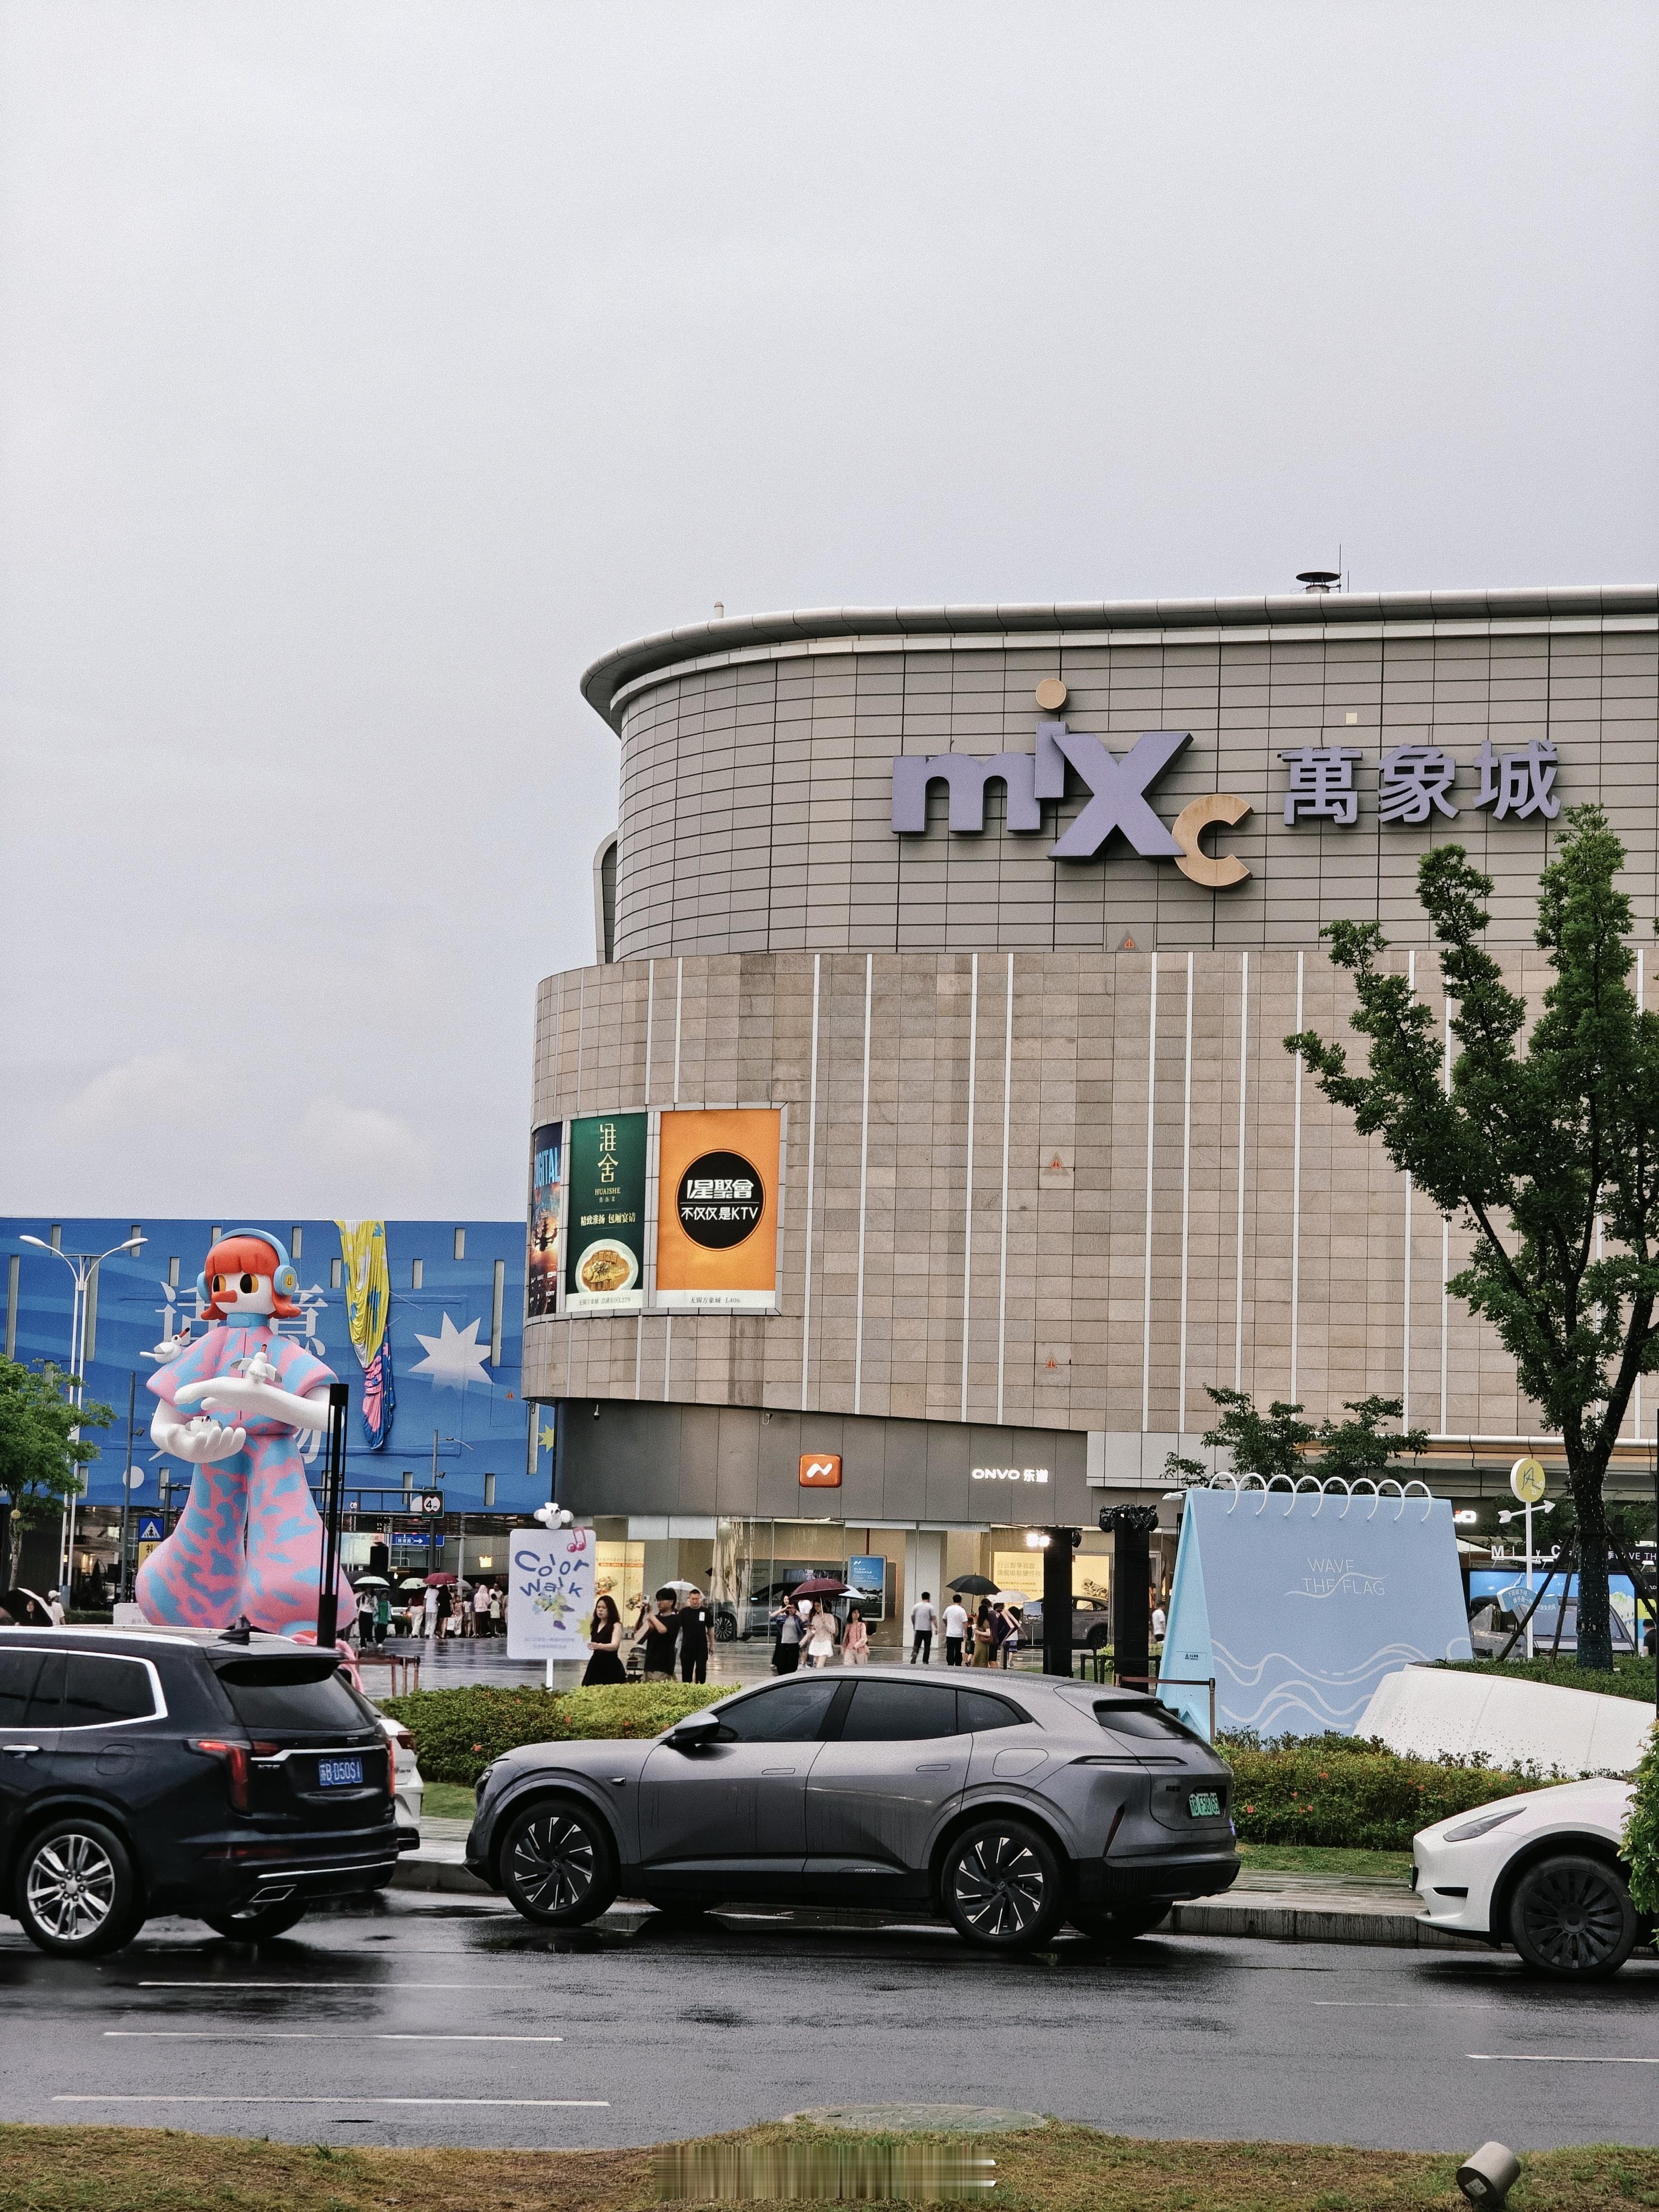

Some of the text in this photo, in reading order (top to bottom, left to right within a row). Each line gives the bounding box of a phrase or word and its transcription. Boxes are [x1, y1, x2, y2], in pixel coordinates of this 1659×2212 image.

[1279, 739, 1560, 826] 萬象城
[595, 1188, 621, 1196] HUAISHE
[681, 1207, 758, 1220] 不仅仅是KTV
[972, 1468, 1020, 1480] ONVO
[515, 1550, 589, 1577] Color
[1307, 1557, 1354, 1573] WAVE
[1302, 1578, 1385, 1595] THE FLAG
